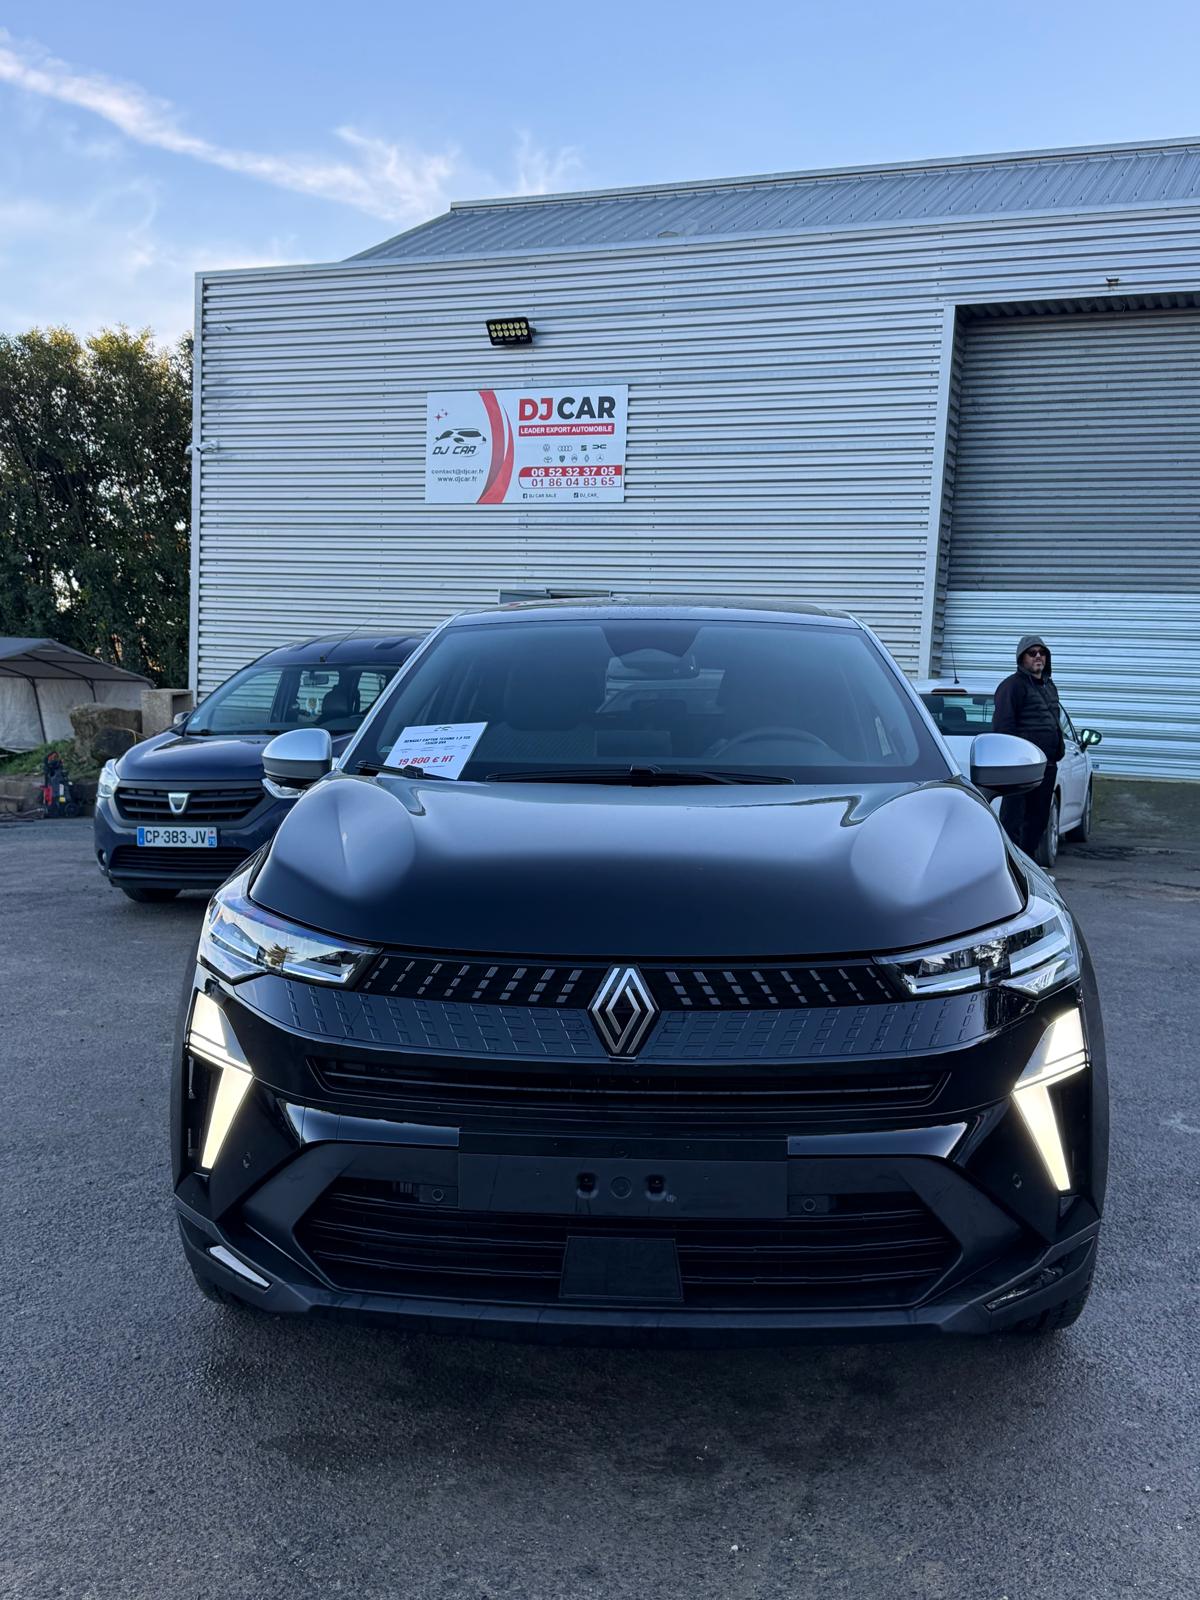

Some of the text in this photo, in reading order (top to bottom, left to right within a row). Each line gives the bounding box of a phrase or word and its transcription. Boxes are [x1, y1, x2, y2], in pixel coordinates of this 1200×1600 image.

[520, 425, 612, 434] LEADER EXPORT AUTOMOBILE
[432, 445, 477, 455] DJ CAR
[431, 468, 484, 476] contact@djcar.fr
[531, 466, 615, 476] 06 52 32 37 05
[531, 477, 615, 487] 01 86 04 83 65
[398, 758, 409, 766] 19
[411, 756, 430, 765] 800
[441, 755, 455, 763] HT
[145, 830, 207, 844] CP-383-JV
